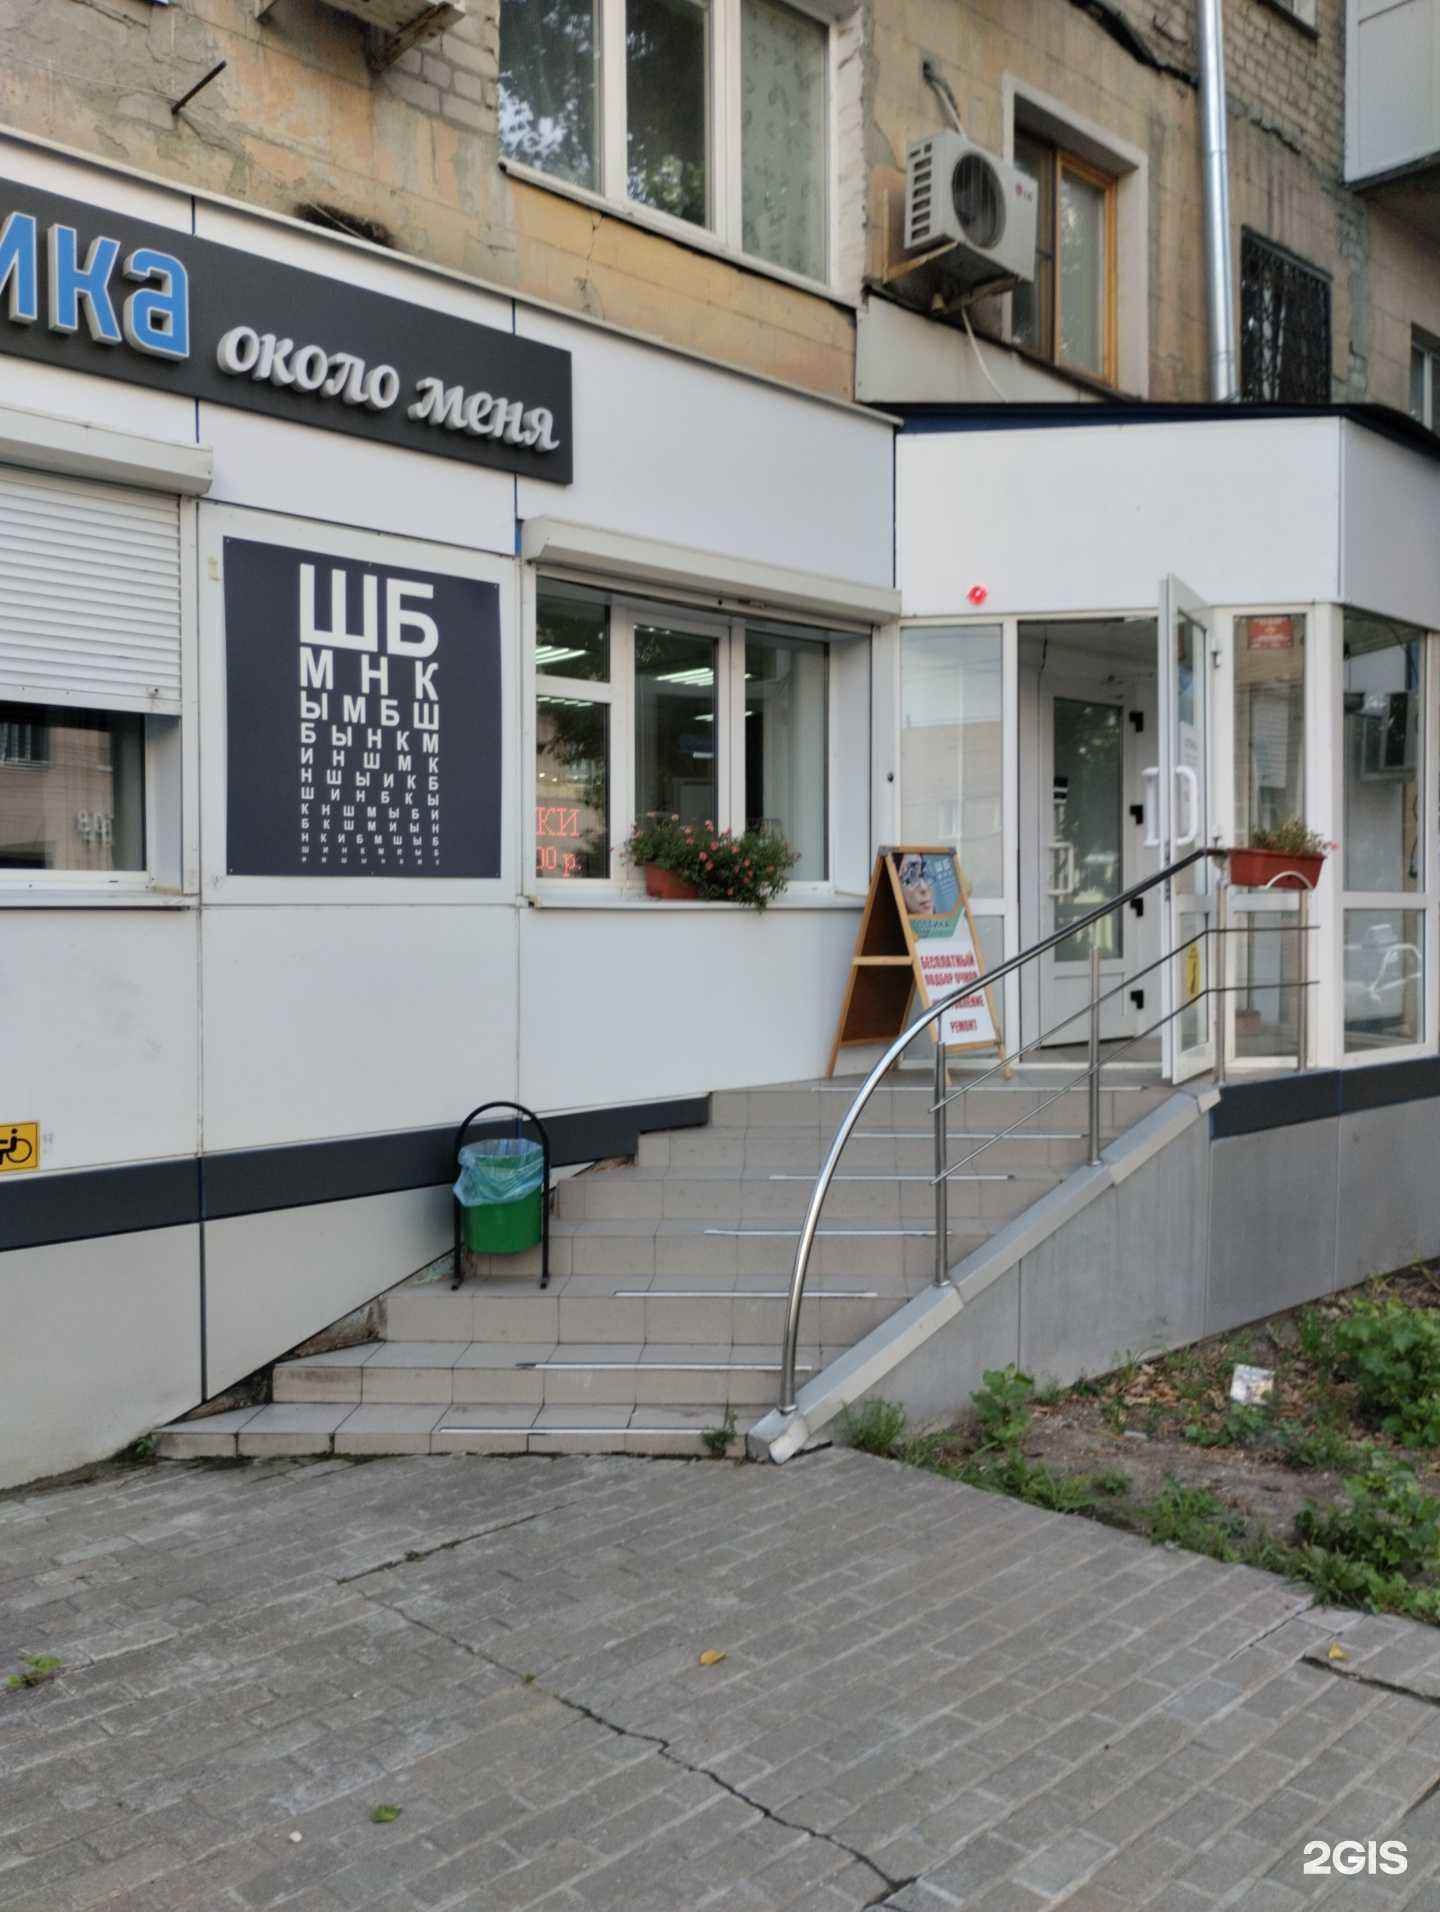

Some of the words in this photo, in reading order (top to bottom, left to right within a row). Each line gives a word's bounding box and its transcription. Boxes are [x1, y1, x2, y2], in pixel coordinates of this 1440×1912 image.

[216, 325, 400, 411] около
[406, 377, 560, 453] меня
[300, 563, 439, 658] ШБ
[300, 646, 334, 690] М
[361, 654, 388, 696] Н
[415, 660, 439, 701] К
[300, 690, 328, 720] Ы
[343, 695, 366, 724] М
[380, 698, 400, 726] Б
[414, 702, 439, 730] Ш
[300, 722, 316, 744] Б
[332, 725, 352, 747] Ы
[367, 728, 382, 749] Н
[397, 730, 410, 751] К
[423, 732, 439, 754] М
[301, 747, 313, 764] И
[333, 750, 344, 767] Н
[364, 752, 380, 769] Ш
[398, 754, 411, 771] М
[429, 756, 438, 773] К
[301, 768, 312, 783] Н
[326, 769, 342, 785] Ш
[356, 772, 370, 786] Ы
[384, 773, 394, 788] И
[407, 774, 416, 789] К
[429, 776, 439, 790] Б
